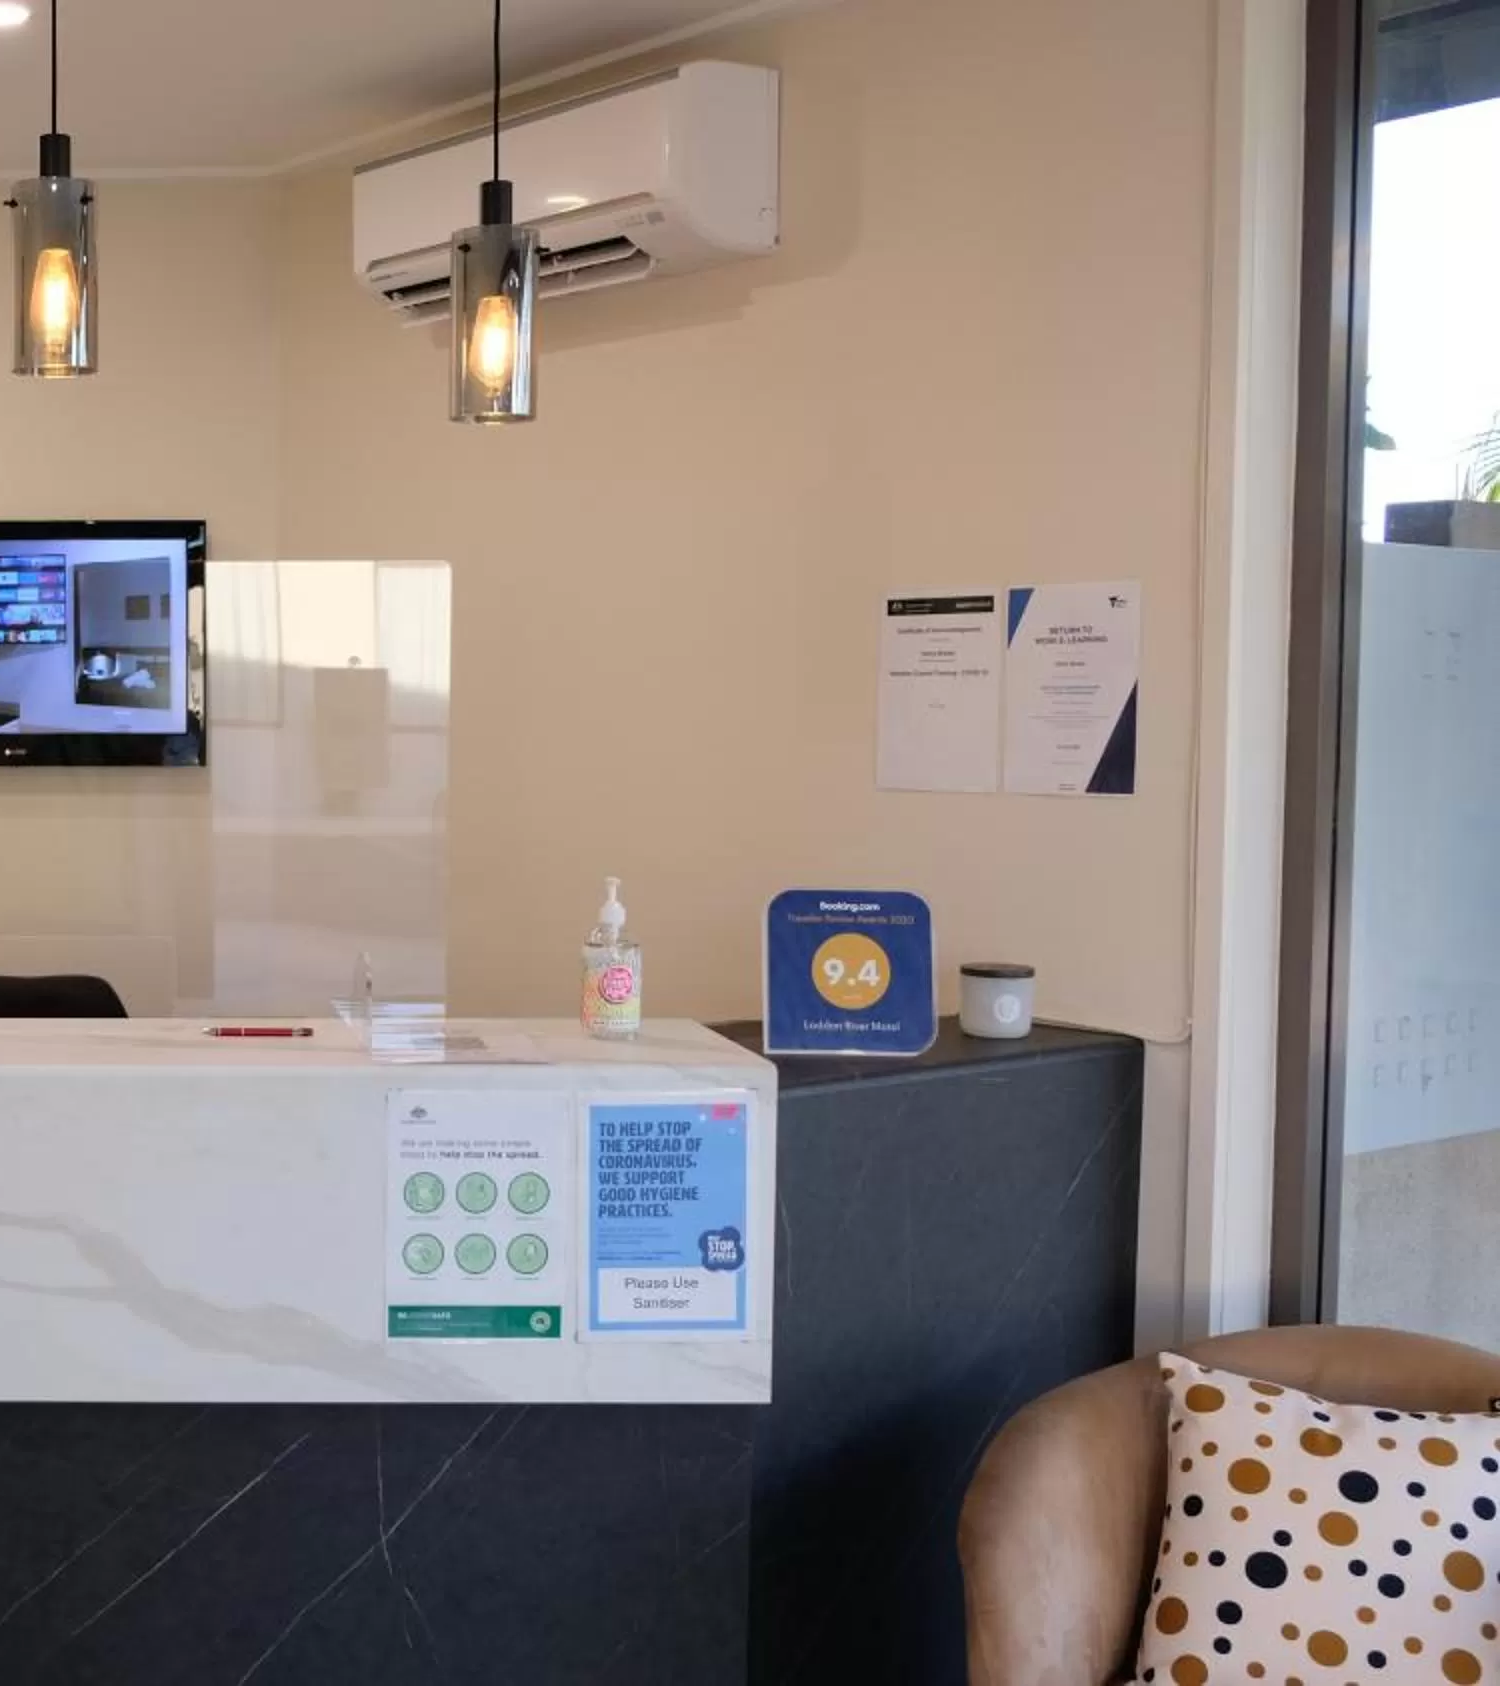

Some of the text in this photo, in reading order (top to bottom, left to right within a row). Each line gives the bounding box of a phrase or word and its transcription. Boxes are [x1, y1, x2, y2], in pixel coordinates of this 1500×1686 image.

[819, 901, 881, 912] Booking.com
[823, 957, 881, 987] 9.4
[599, 1121, 692, 1137] TO HELP STOP
[599, 1137, 703, 1153] THE SPREAD OF
[598, 1154, 698, 1169] CORONAVIRUS.
[599, 1170, 686, 1185] WE SUPPORT
[599, 1186, 701, 1201] GOOD HYGIENE
[598, 1202, 674, 1218] PRACTICES.
[624, 1275, 700, 1290] Please Use
[632, 1297, 692, 1309] Sanitiser
